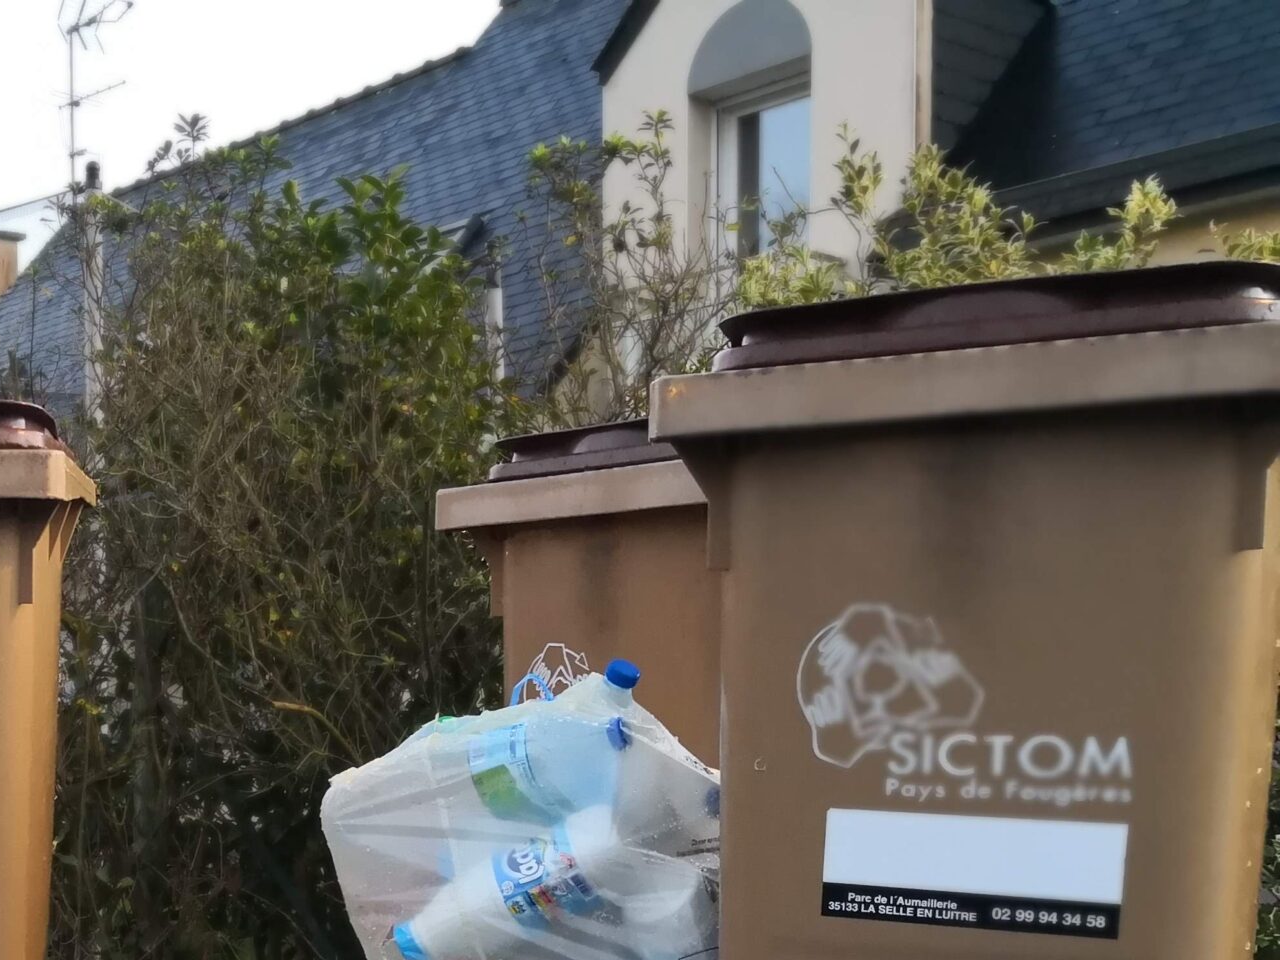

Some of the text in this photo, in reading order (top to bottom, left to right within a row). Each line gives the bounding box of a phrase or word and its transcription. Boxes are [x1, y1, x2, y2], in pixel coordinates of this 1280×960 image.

[887, 732, 1133, 780] SICTOM
[885, 777, 1133, 806] Pays de Fougères
[848, 892, 871, 903] Parc
[874, 894, 888, 904] de
[828, 901, 977, 922] 35133 LA SELLE EN LUITRE
[992, 907, 1106, 928] 02 99 94 34 58
